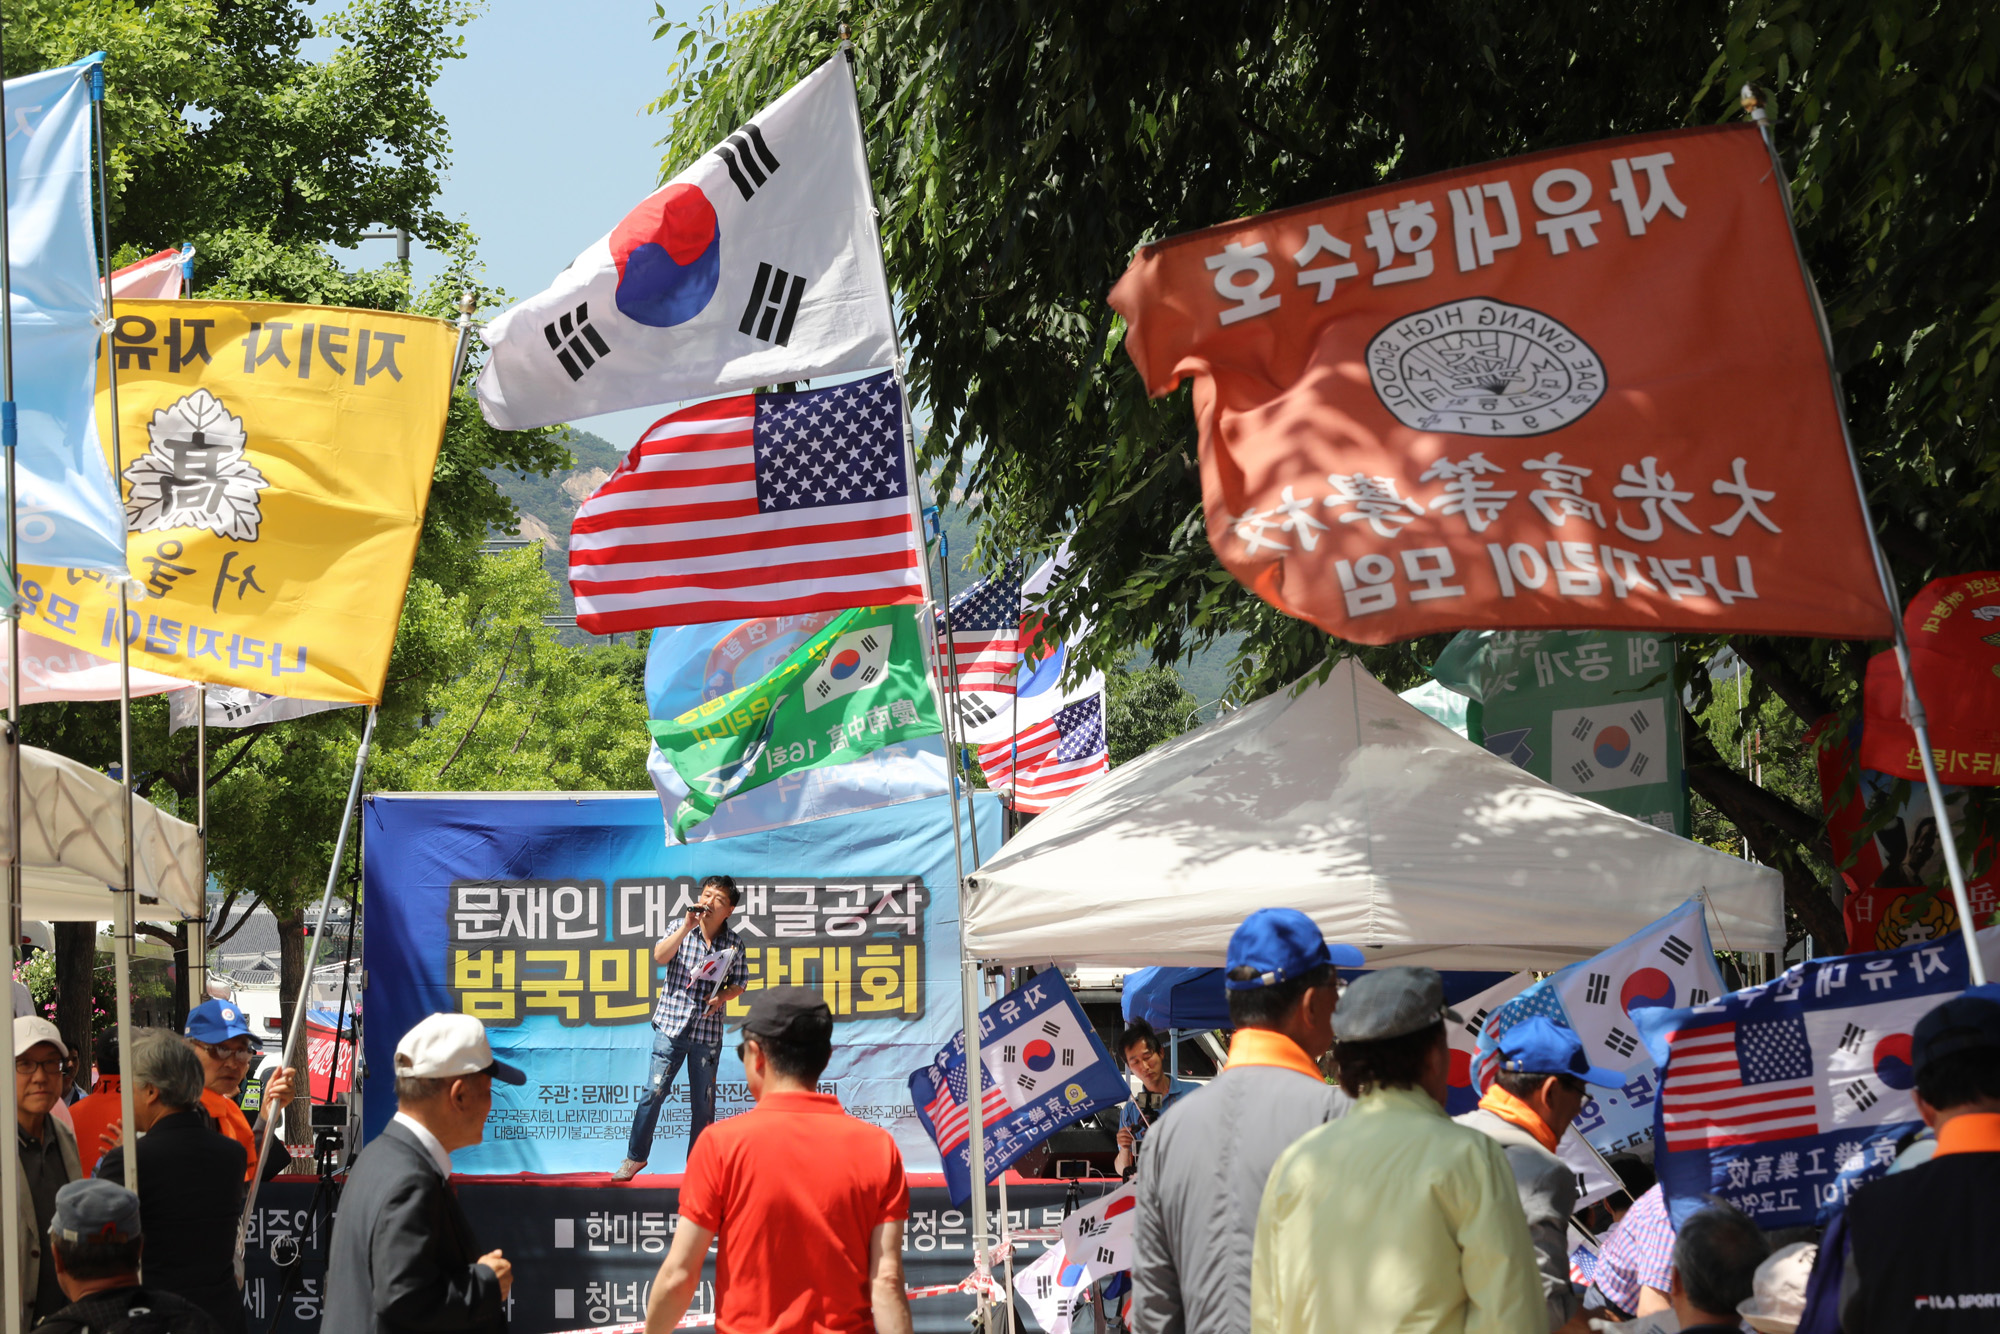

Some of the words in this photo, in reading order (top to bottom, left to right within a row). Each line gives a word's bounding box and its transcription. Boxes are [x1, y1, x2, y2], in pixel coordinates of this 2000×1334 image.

[454, 886, 599, 940] 문재인
[454, 944, 918, 1020] 범국민탄대회
[537, 1084, 571, 1105] 주관
[581, 1084, 629, 1105] 문재인
[486, 1108, 555, 1125] 군구국동지회,
[557, 1108, 637, 1125] 나라지킴이고교
[1914, 1293, 1957, 1311] FILA
